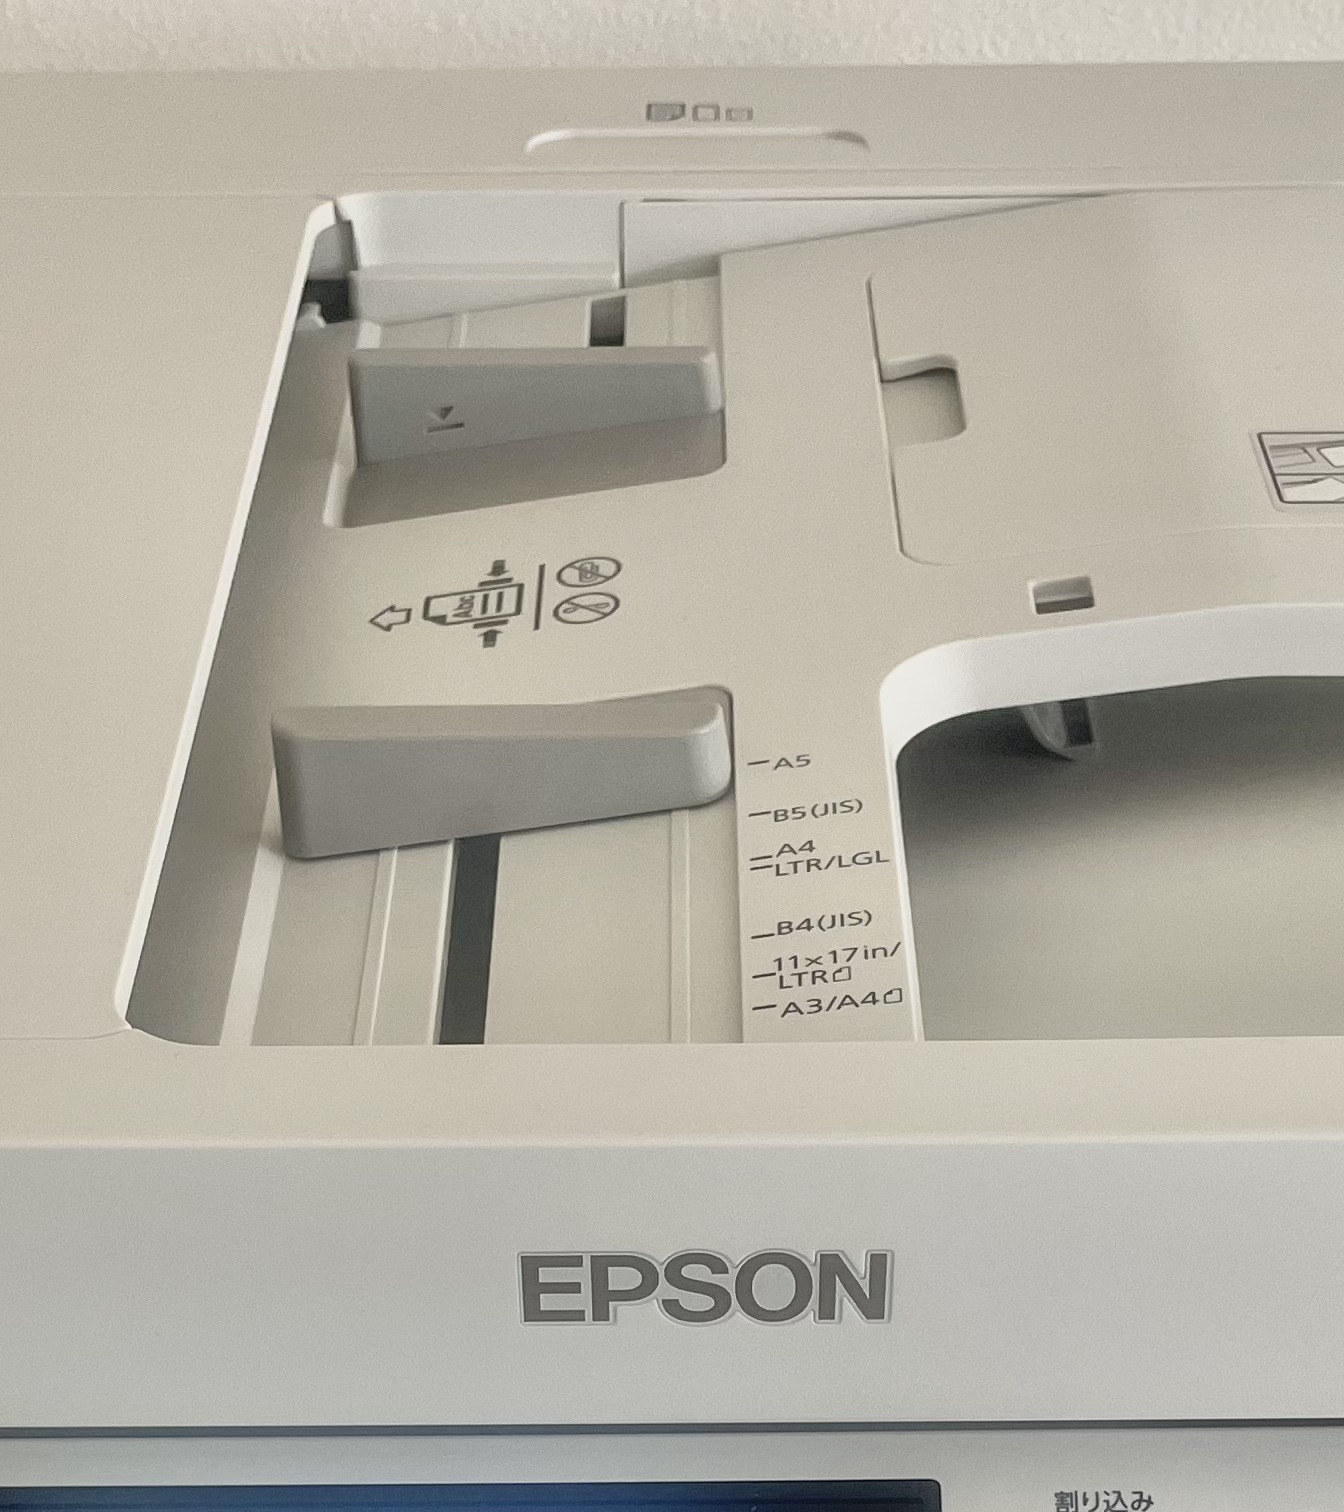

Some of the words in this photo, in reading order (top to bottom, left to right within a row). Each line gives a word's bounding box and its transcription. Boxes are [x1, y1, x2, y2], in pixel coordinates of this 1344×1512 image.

[772, 754, 811, 771] A5
[773, 798, 863, 823] B5(JIS)
[776, 840, 816, 858] A4
[775, 850, 890, 877] LTR/LGL
[777, 910, 872, 936] B4(JIS)
[779, 969, 828, 989] LTR
[781, 991, 879, 1018] A3/A4
[520, 1251, 889, 1323] EPSON
